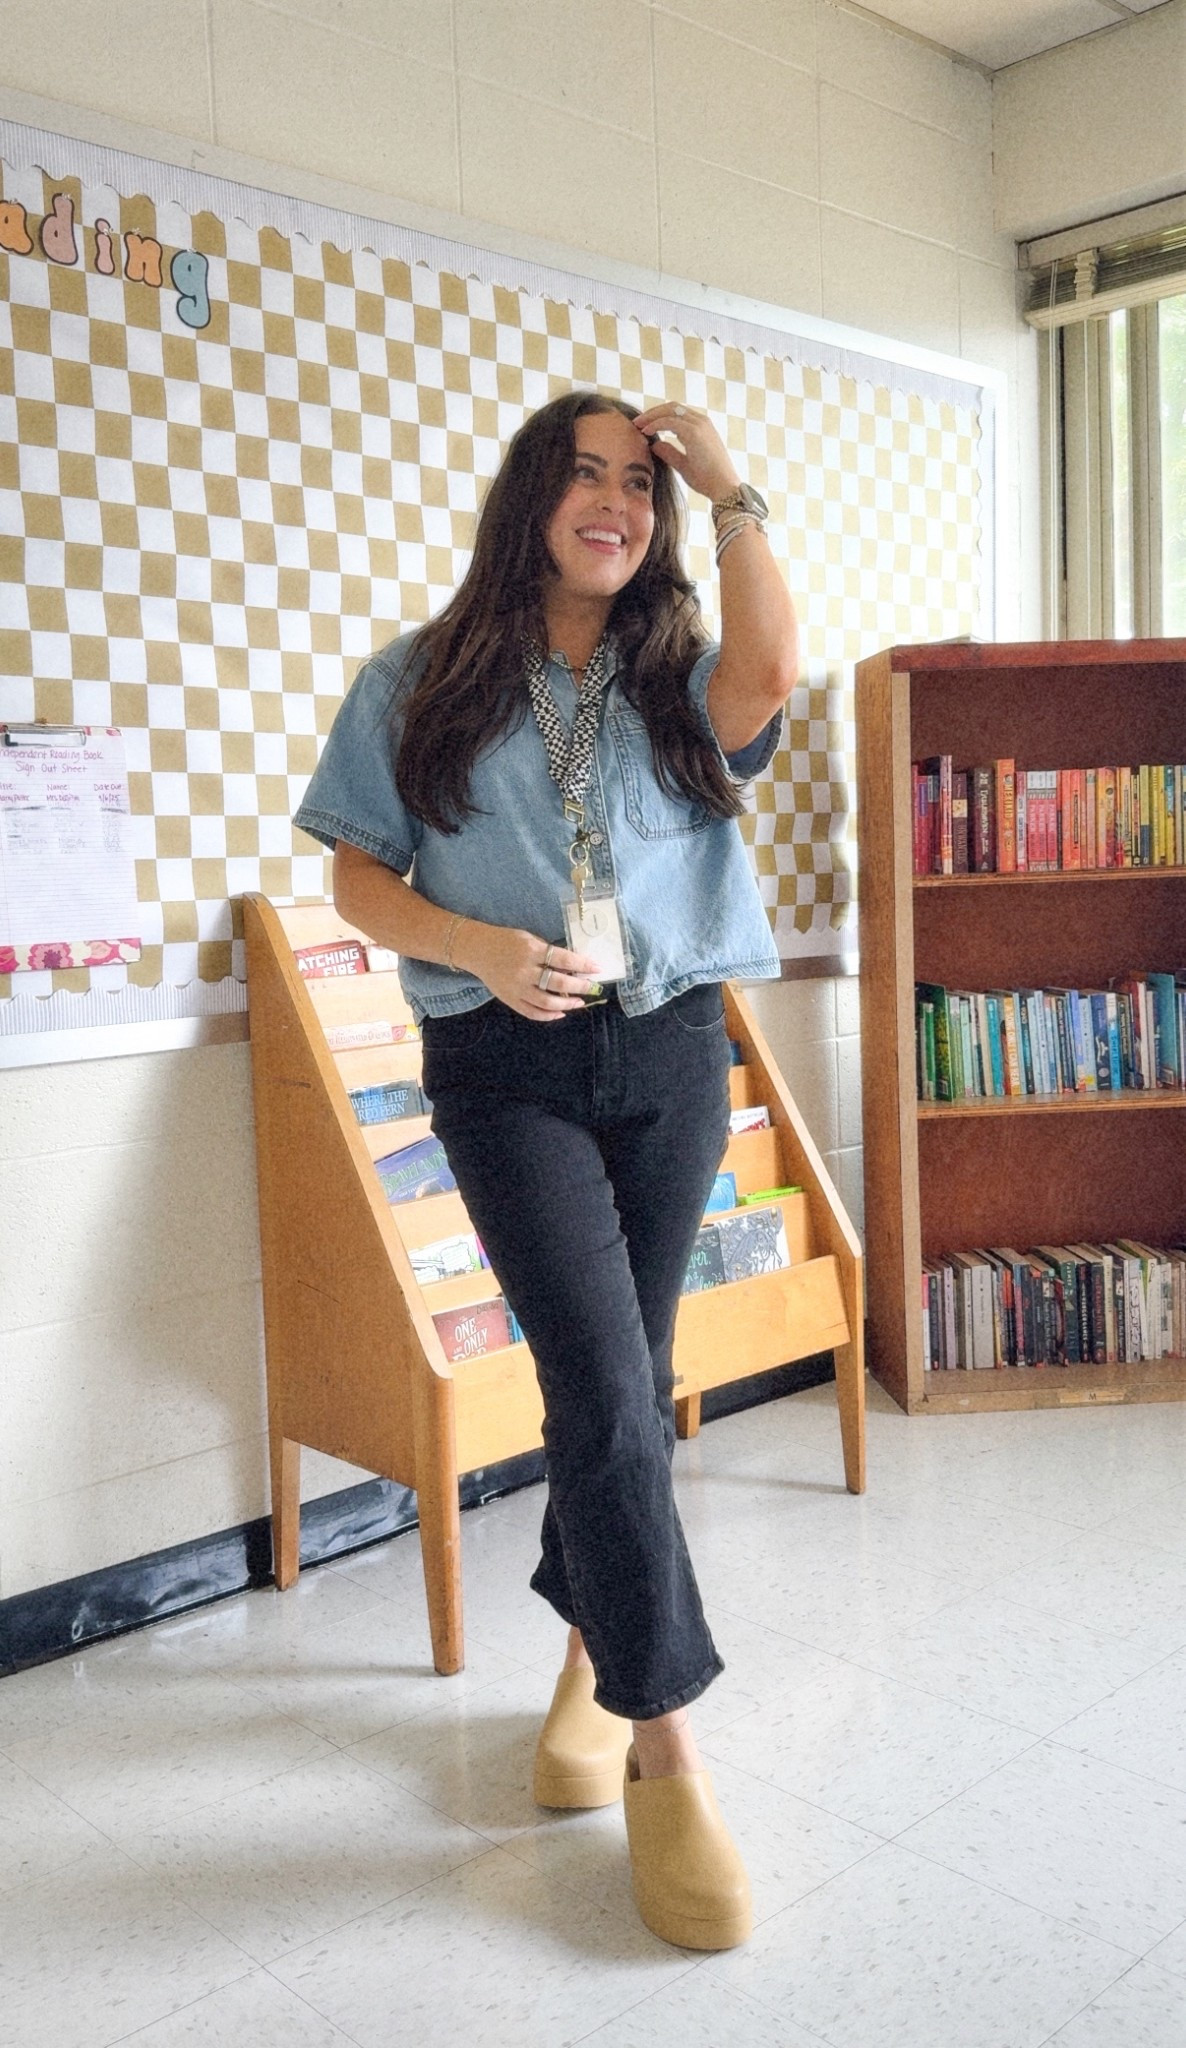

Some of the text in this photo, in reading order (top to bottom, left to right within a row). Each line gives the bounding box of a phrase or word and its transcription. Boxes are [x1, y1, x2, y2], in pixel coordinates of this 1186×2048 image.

[49, 748, 81, 763] Reading
[83, 749, 104, 760] Book
[15, 761, 88, 776] Sign Out Sheet
[1003, 784, 1014, 820] MEXIKID
[351, 1089, 409, 1110] WHERE THE
[357, 1107, 379, 1121] RED
[379, 1102, 406, 1117] FERN
[454, 1317, 478, 1343] ONE
[464, 1327, 488, 1356] ONLY
